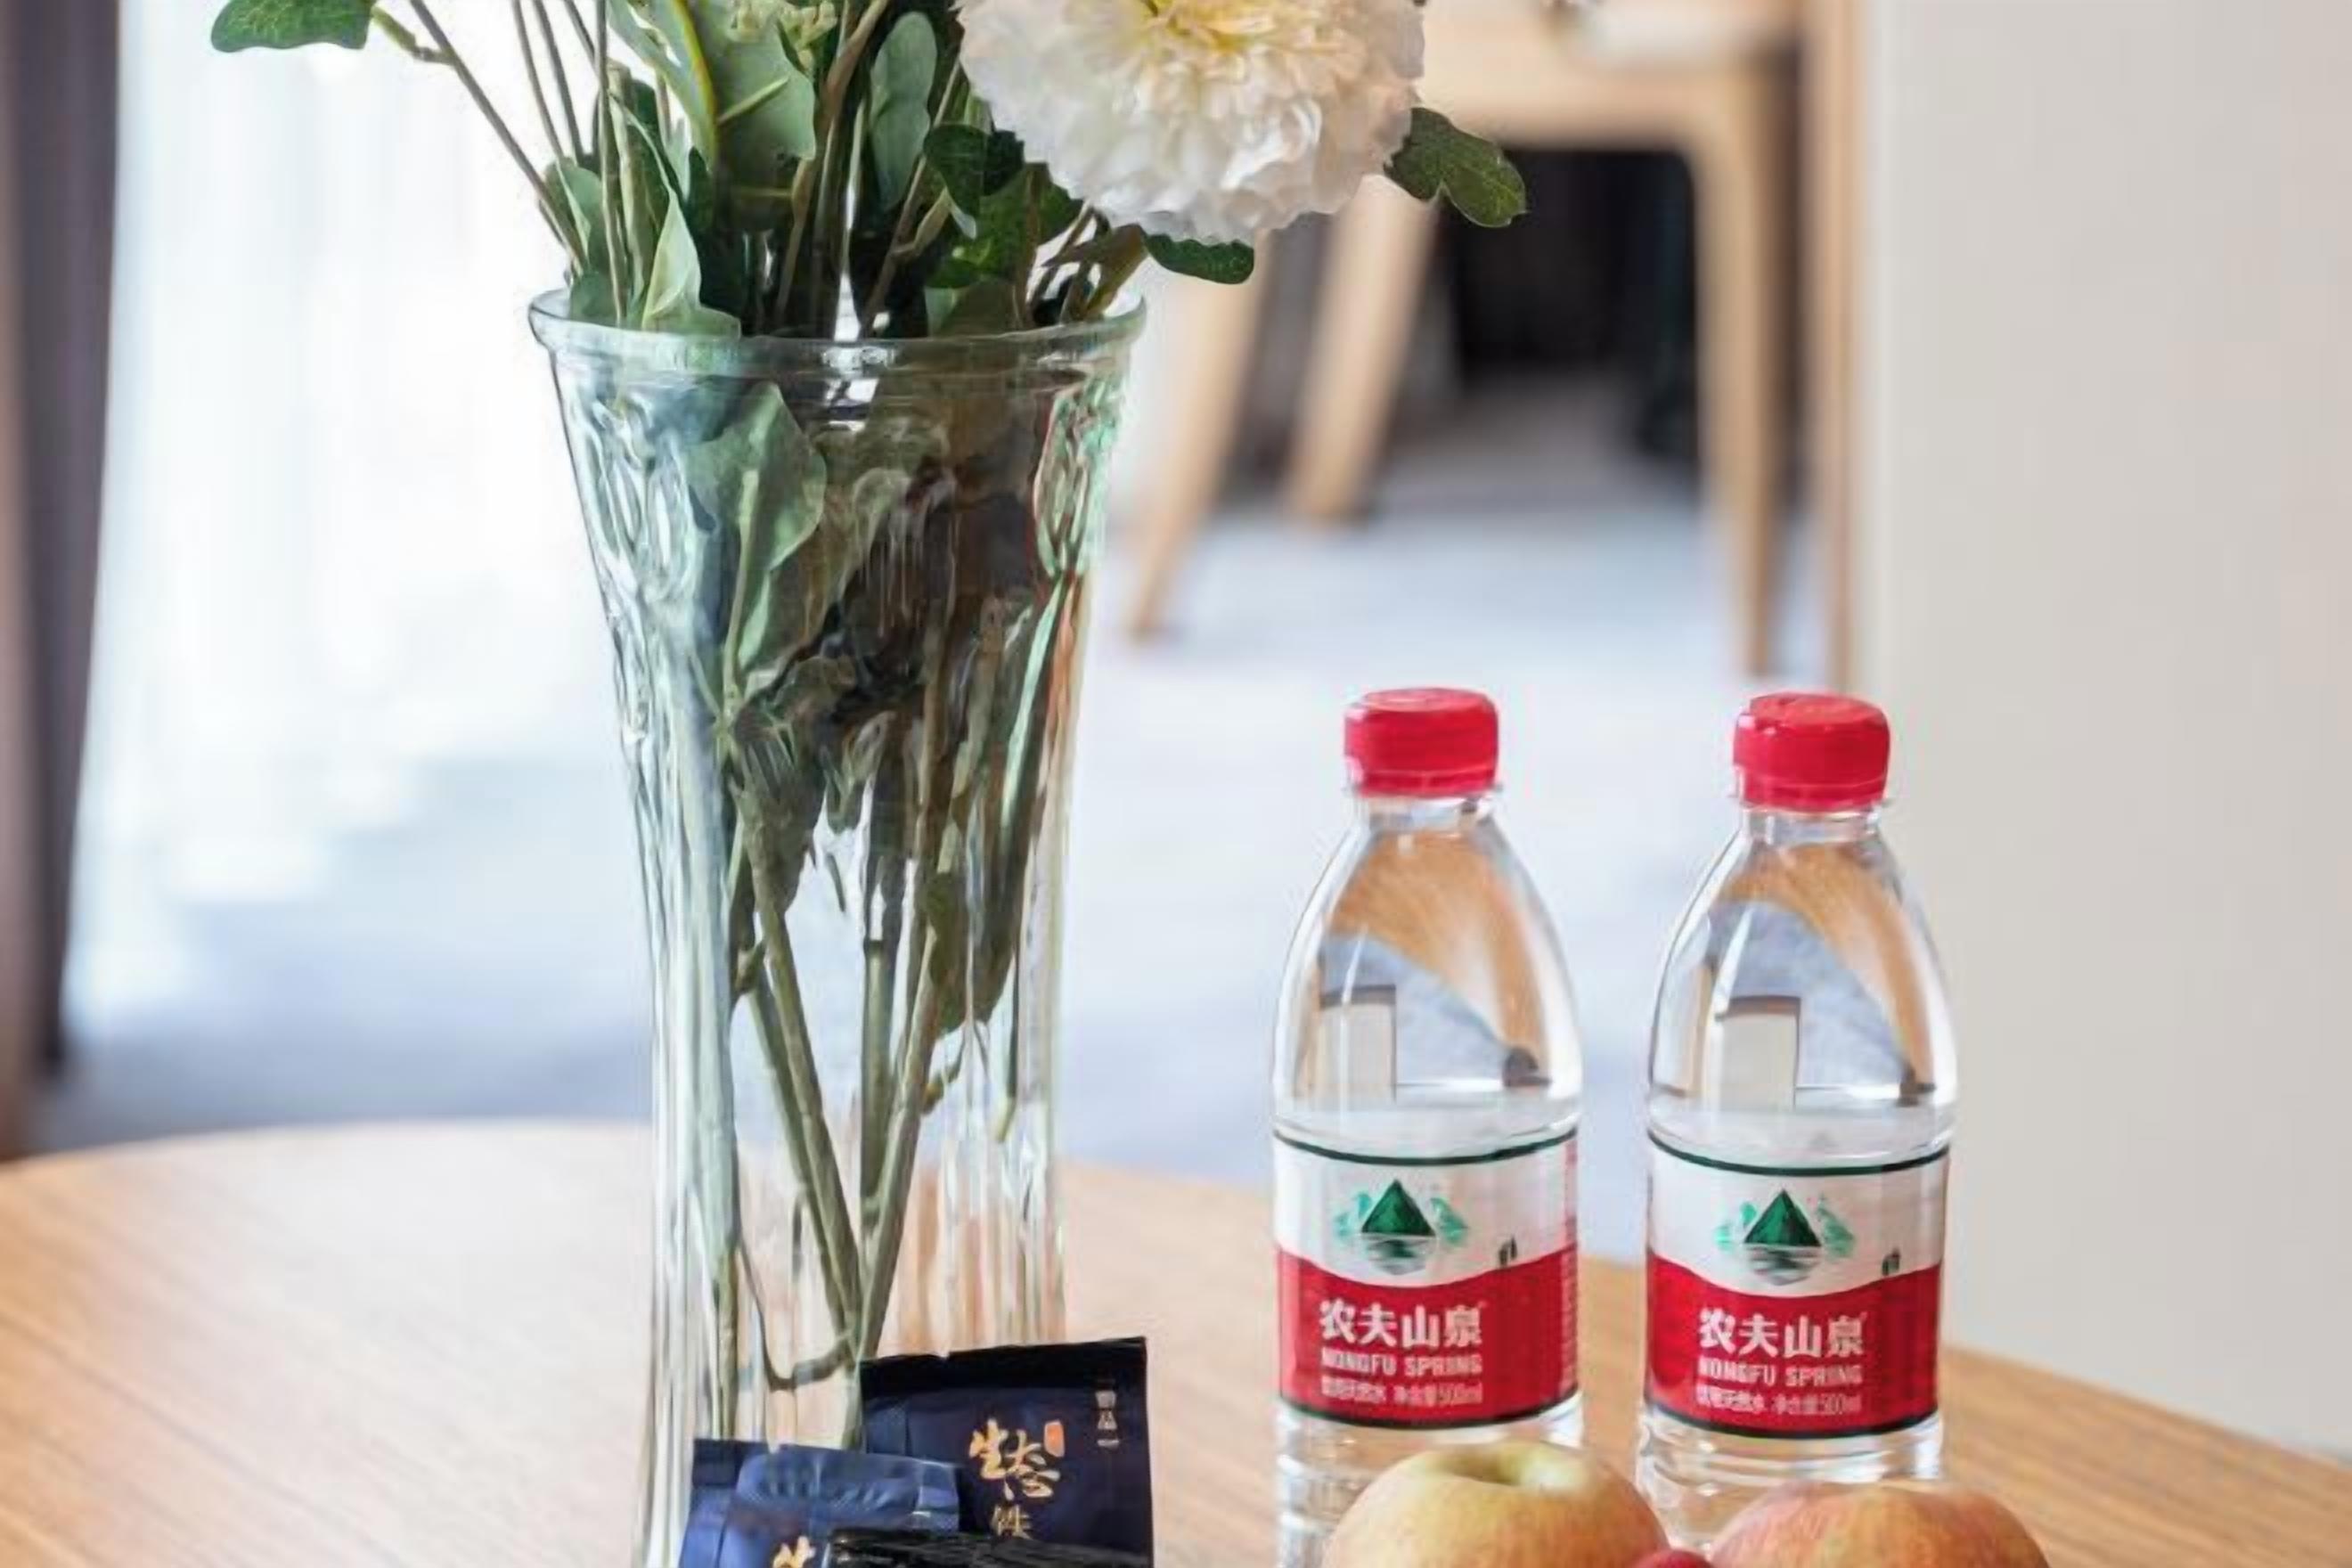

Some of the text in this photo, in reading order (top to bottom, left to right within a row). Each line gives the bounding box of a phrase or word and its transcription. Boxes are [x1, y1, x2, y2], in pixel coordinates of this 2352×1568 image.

[1319, 1298, 1483, 1348] 农夫山泉
[1698, 1307, 1864, 1358] 农夫山泉
[1321, 1346, 1483, 1377] NONGFU SPRING
[1697, 1354, 1863, 1387] NONGFU SPRING
